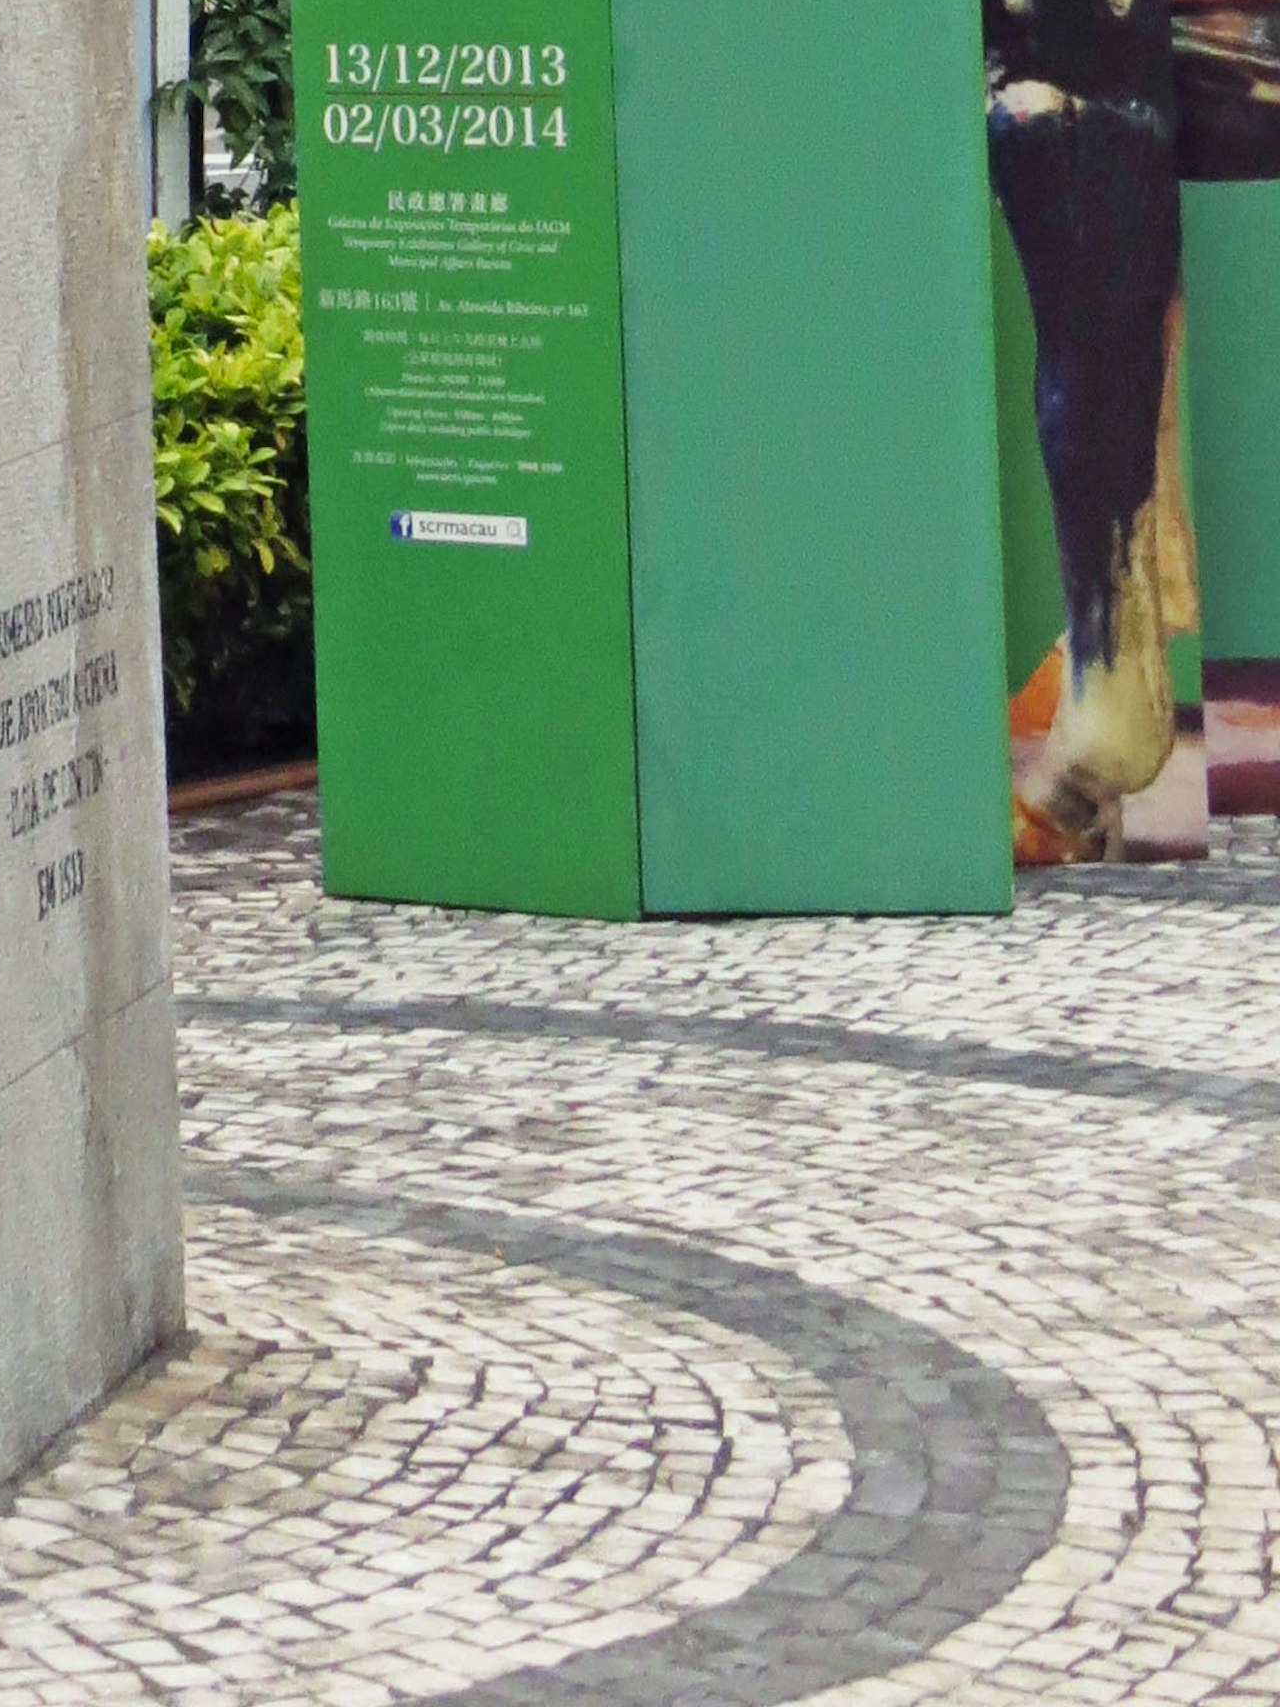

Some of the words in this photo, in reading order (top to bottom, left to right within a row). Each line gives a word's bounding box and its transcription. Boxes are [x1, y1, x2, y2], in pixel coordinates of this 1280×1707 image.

[325, 42, 567, 93] 13/12/2013
[322, 103, 568, 154] 02/03/2014
[418, 517, 497, 537] scrmacau
